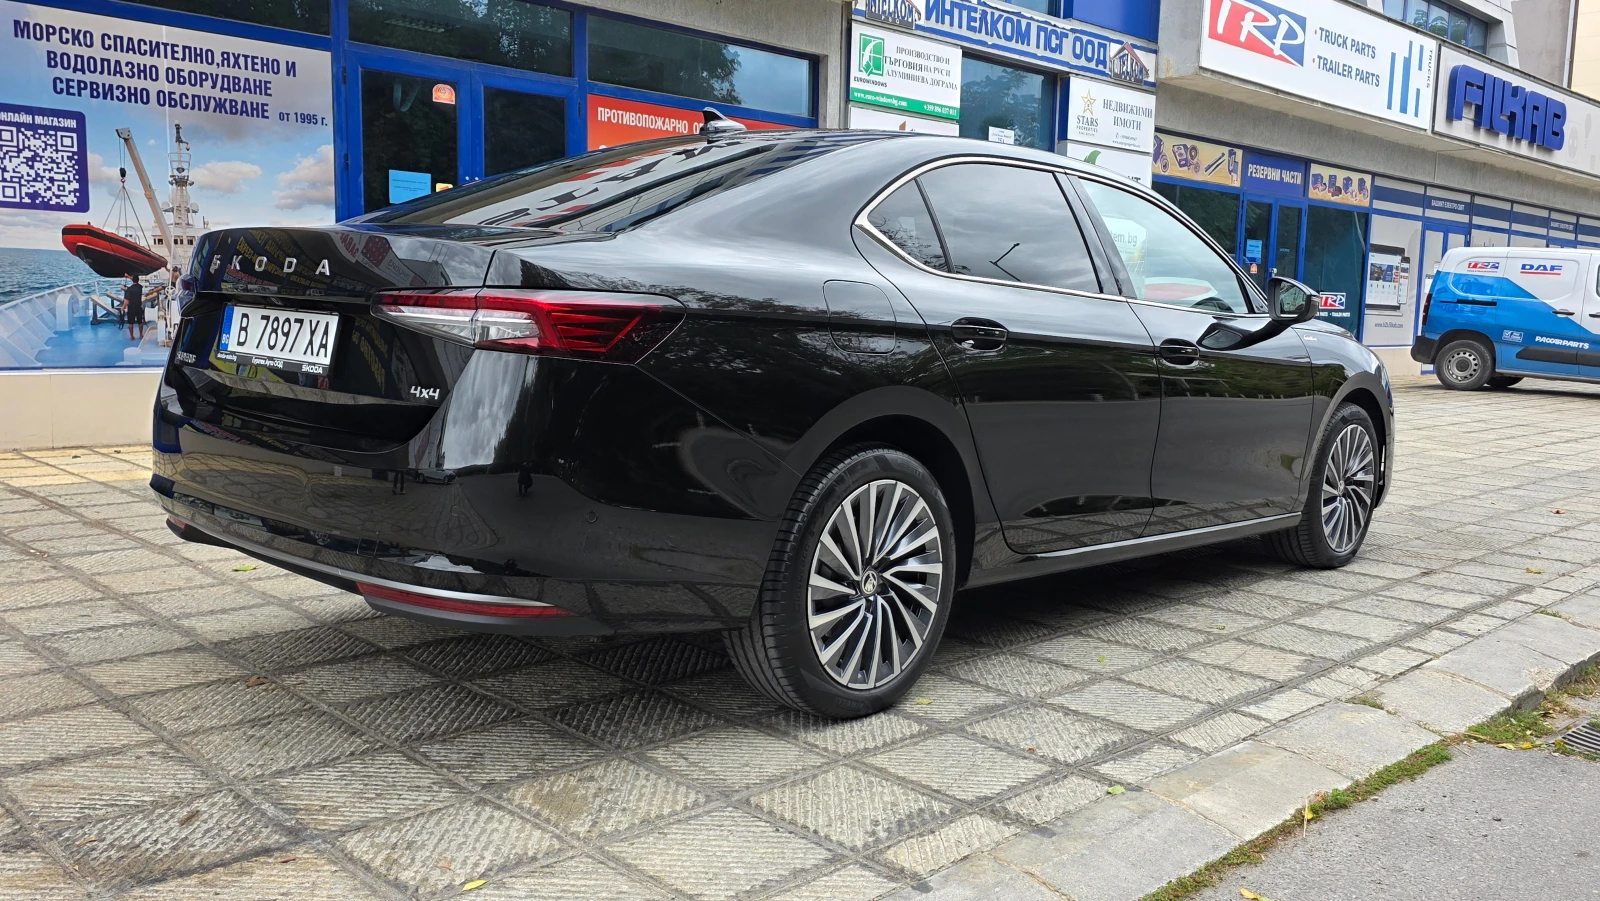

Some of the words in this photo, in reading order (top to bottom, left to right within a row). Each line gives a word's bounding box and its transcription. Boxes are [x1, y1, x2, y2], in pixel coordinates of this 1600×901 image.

[925, 0, 1031, 46] ИНТЕЛКОМ
[1036, 24, 1069, 55] ПСГ
[1072, 35, 1108, 69] ООД
[1214, 0, 1305, 56] TRP
[13, 19, 95, 48] МОРСКО
[285, 61, 297, 78] И
[1319, 26, 1348, 50] TRUCK
[1350, 37, 1377, 60] PARTS
[884, 55, 923, 72] ТЪРГОВИЯ
[923, 64, 932, 74] НА
[945, 69, 951, 77] И
[896, 46, 944, 63] ПРОИЗВОДСТВО
[945, 57, 950, 66] И
[46, 50, 159, 82] ВОДОЛАЗНО
[165, 67, 273, 97] ОБОРУДВАНЕ
[853, 76, 887, 88] EUROWINDOWS
[886, 69, 929, 85] АЛУМИНИЕВА
[929, 77, 958, 91] ДОГРАМА
[1317, 55, 1353, 79] TRAILER
[1354, 69, 1380, 88] PARTS
[52, 76, 151, 106] СЕРВИЗНО
[156, 90, 270, 120] ОБСЛУЖВАНЕ
[293, 111, 318, 126] 1995
[320, 116, 328, 127] г.
[1102, 98, 1153, 119] НЕДВИЖИМИ
[1446, 64, 1567, 151] FILKAB
[0, 112, 33, 124] НЛАЙН
[34, 115, 77, 129] МАГАЗИН
[597, 106, 689, 134] ПРОТИВОПОЖАРНО
[1076, 115, 1099, 128] STARS
[1113, 116, 1142, 131] ИМОТИ
[1248, 164, 1280, 182] РЕЗЕРВНИ
[1281, 169, 1302, 185] ЧАСТИ
[1468, 261, 1499, 270] TRP
[1521, 263, 1564, 272] DAF
[1319, 294, 1345, 307] TRP
[237, 312, 250, 346] B
[256, 314, 304, 353] 7897
[303, 319, 330, 358] XA
[1561, 339, 1590, 350] PARTS
[410, 385, 440, 400] 4x4
